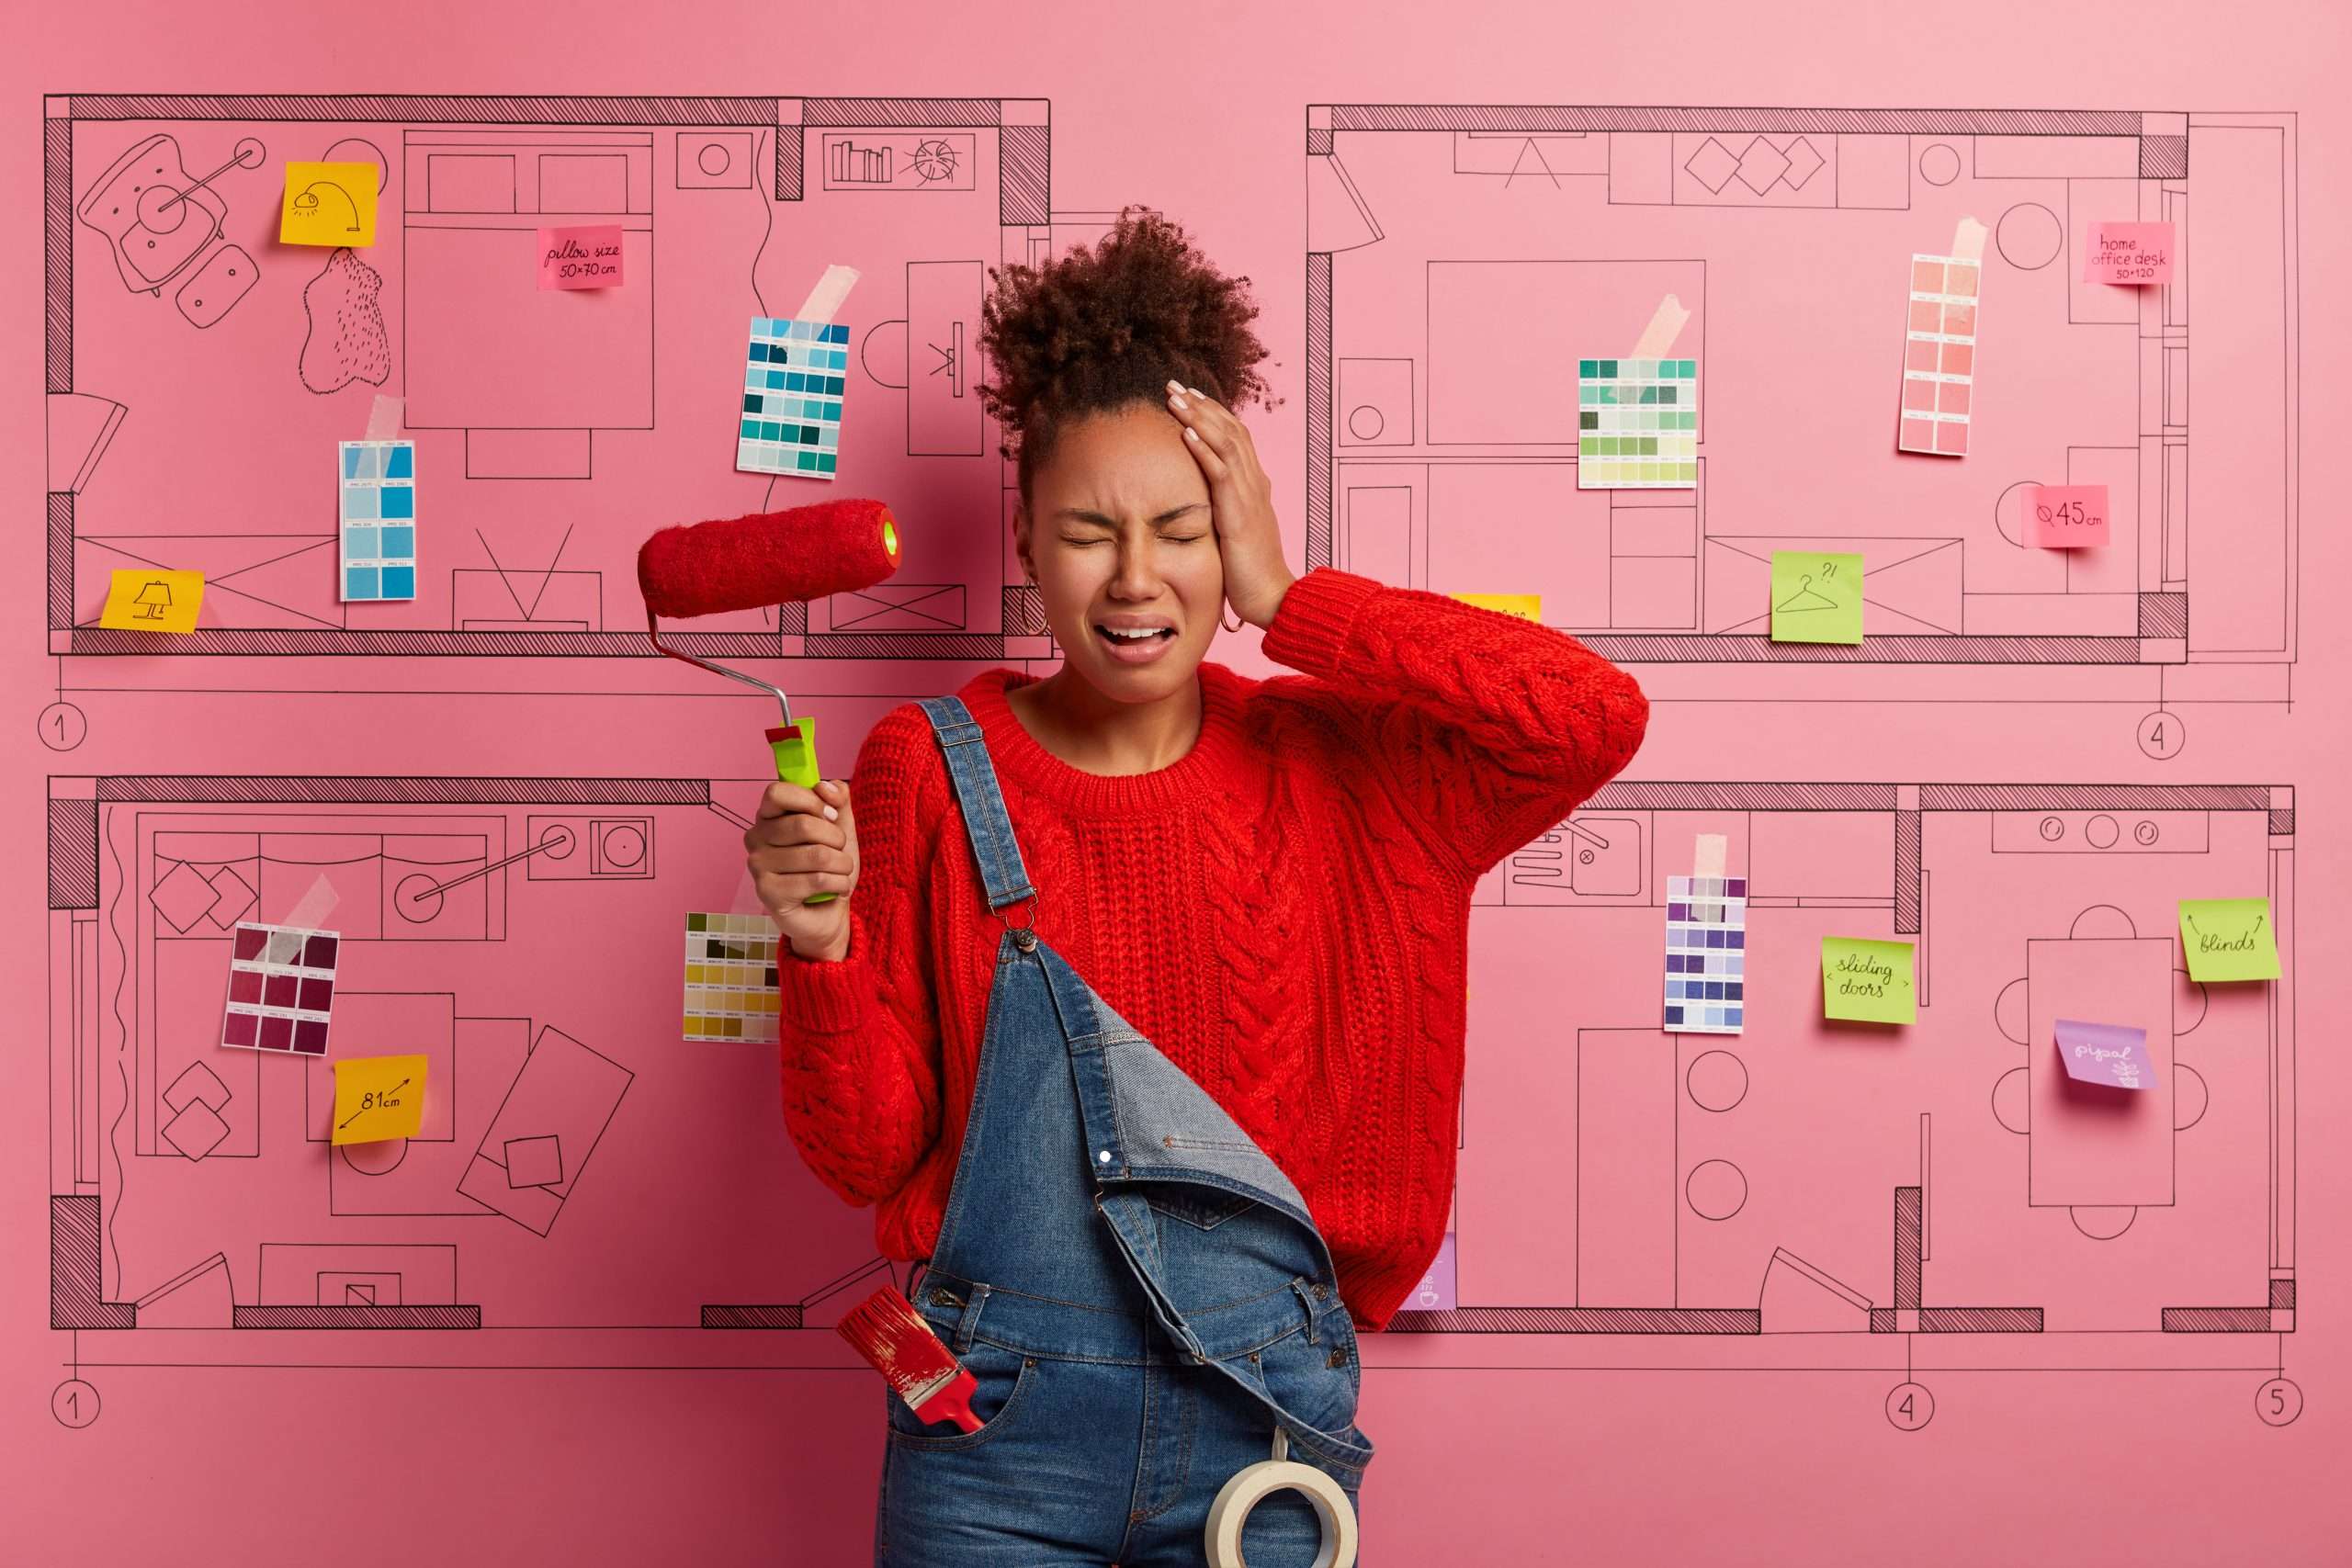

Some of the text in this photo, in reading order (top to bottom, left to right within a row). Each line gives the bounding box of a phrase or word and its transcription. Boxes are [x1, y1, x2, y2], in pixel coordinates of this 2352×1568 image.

[544, 239, 620, 267] pillow size
[2099, 232, 2137, 251] home
[2091, 249, 2167, 266] office desk
[54, 714, 64, 742] 1
[2151, 721, 2164, 750] 4
[2200, 930, 2256, 953] blinds
[1836, 953, 1893, 986] sliding
[1839, 977, 1884, 998] doors
[66, 1392, 78, 1420] 1
[1898, 1393, 1913, 1422] 4
[2271, 1388, 2285, 1416] 5
